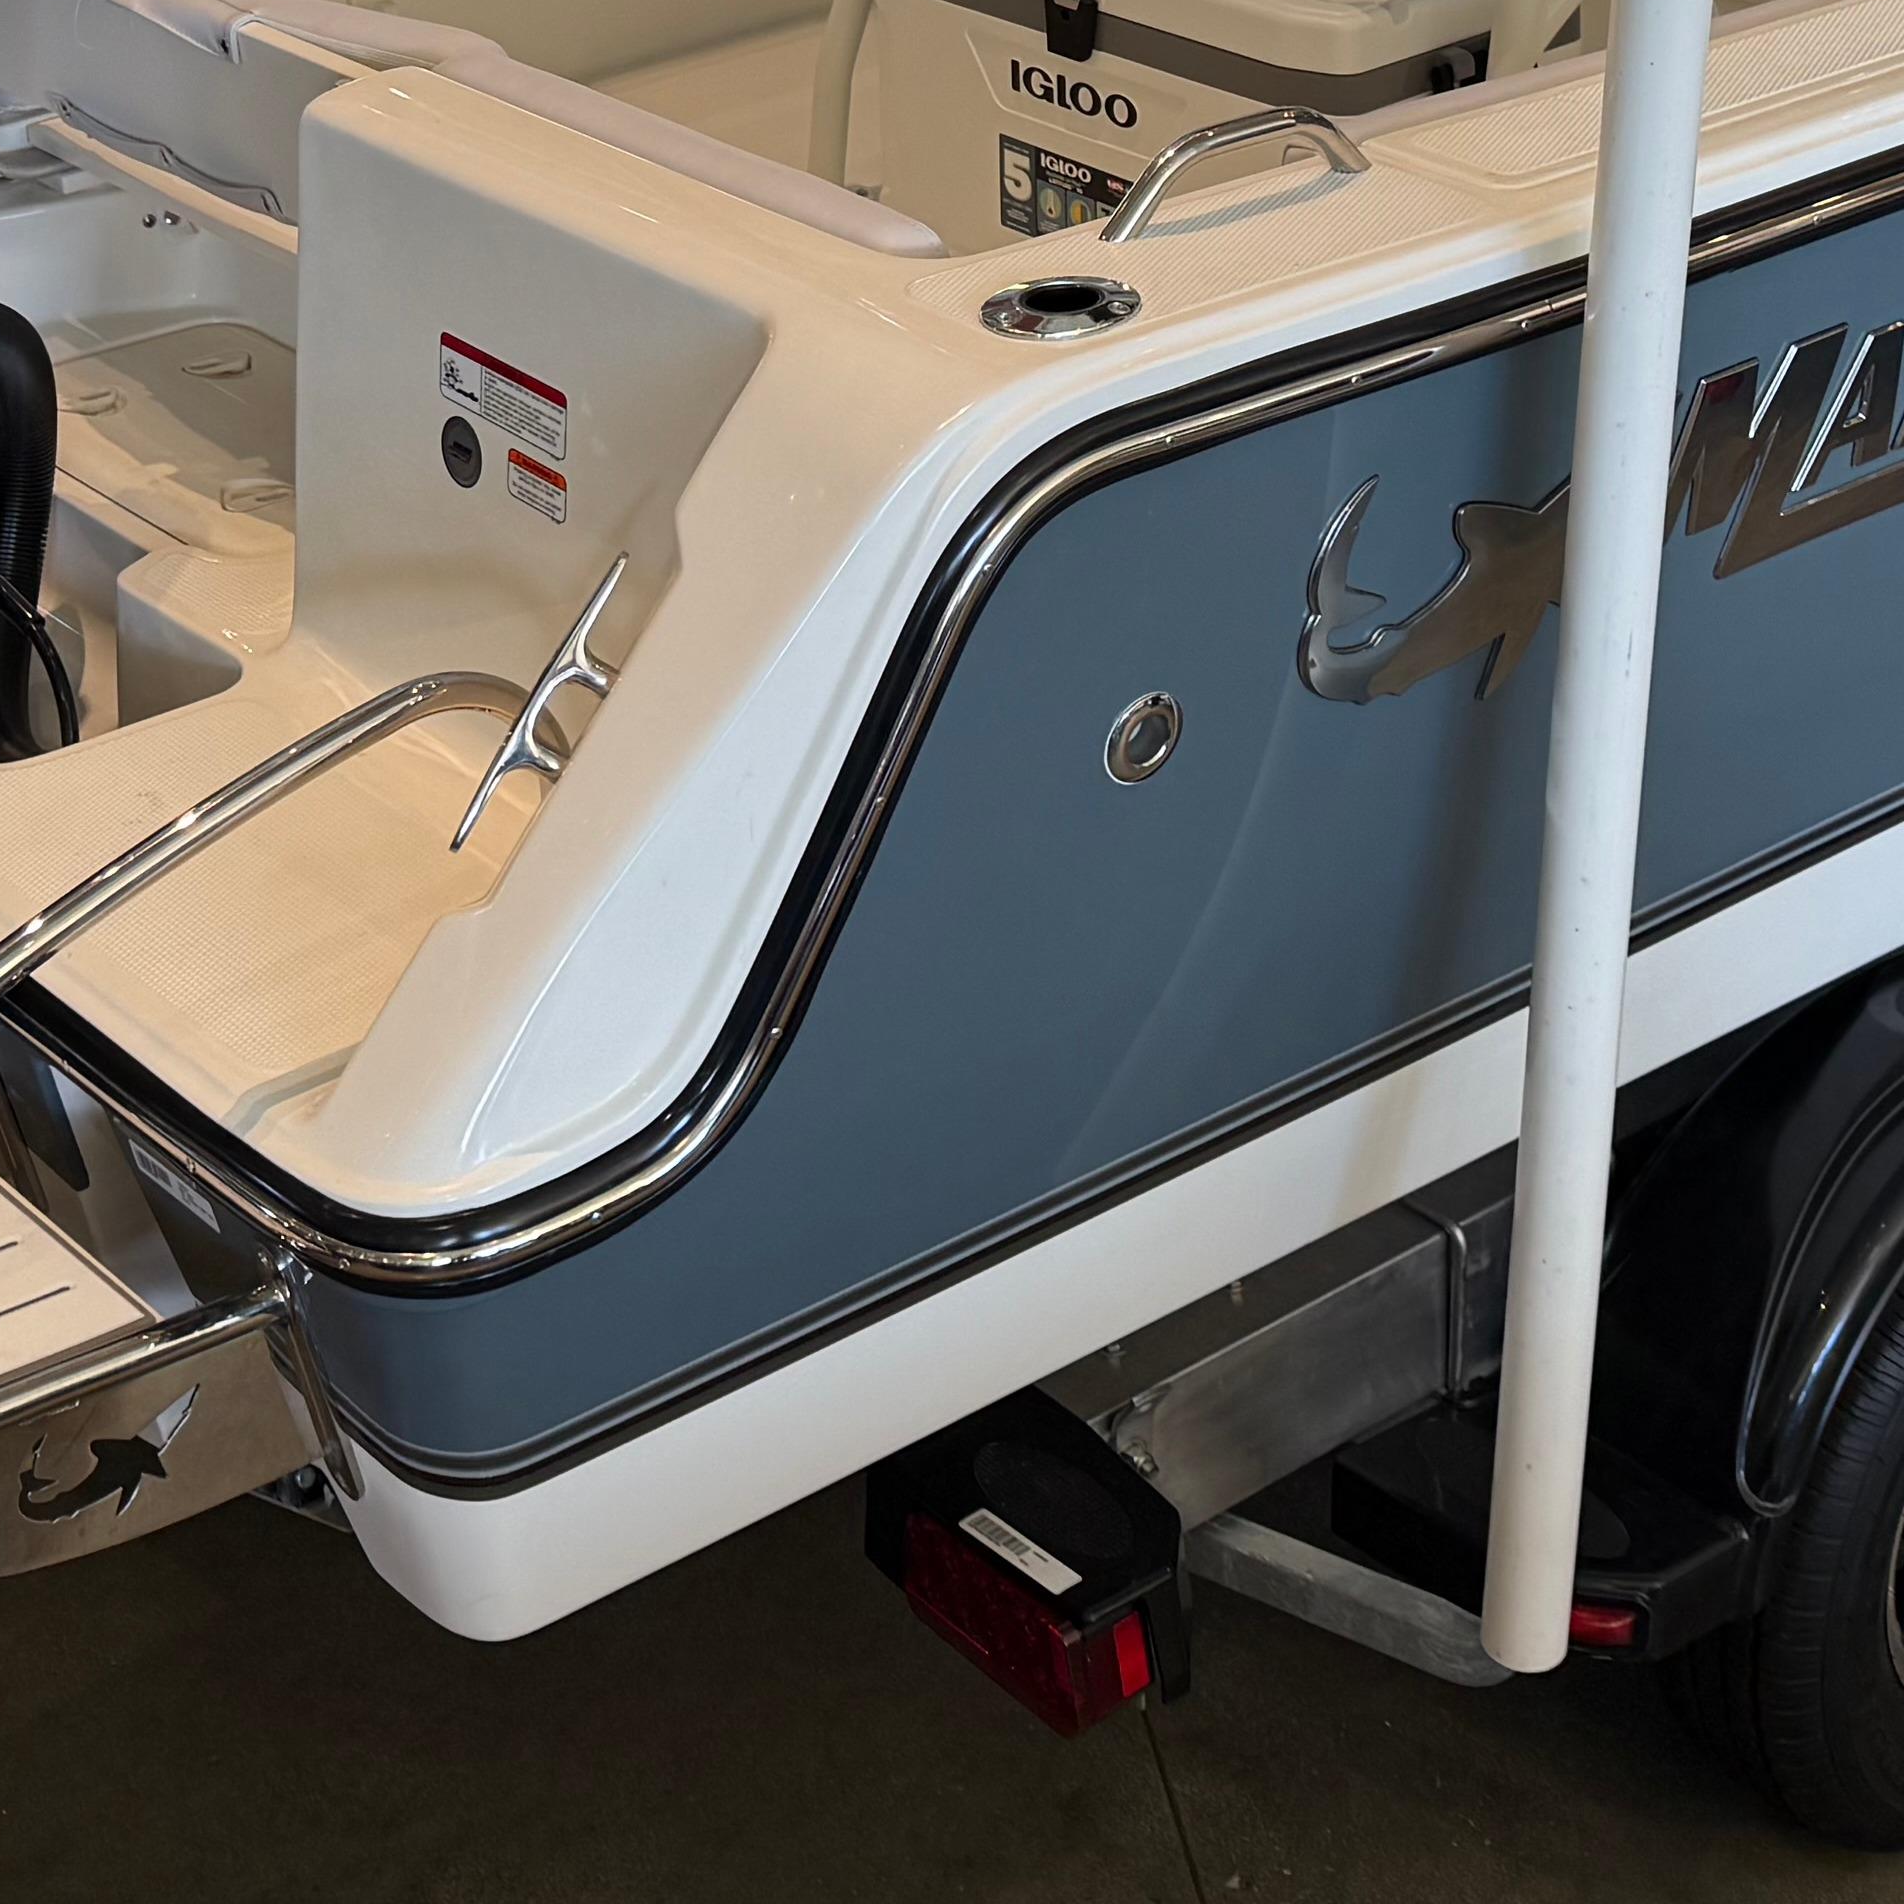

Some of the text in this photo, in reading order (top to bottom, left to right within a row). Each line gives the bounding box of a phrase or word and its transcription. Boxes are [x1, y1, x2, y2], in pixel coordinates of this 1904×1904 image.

[1010, 58, 1138, 129] IGLOO
[1004, 148, 1033, 203] 5
[1040, 152, 1092, 184] IGLOO
